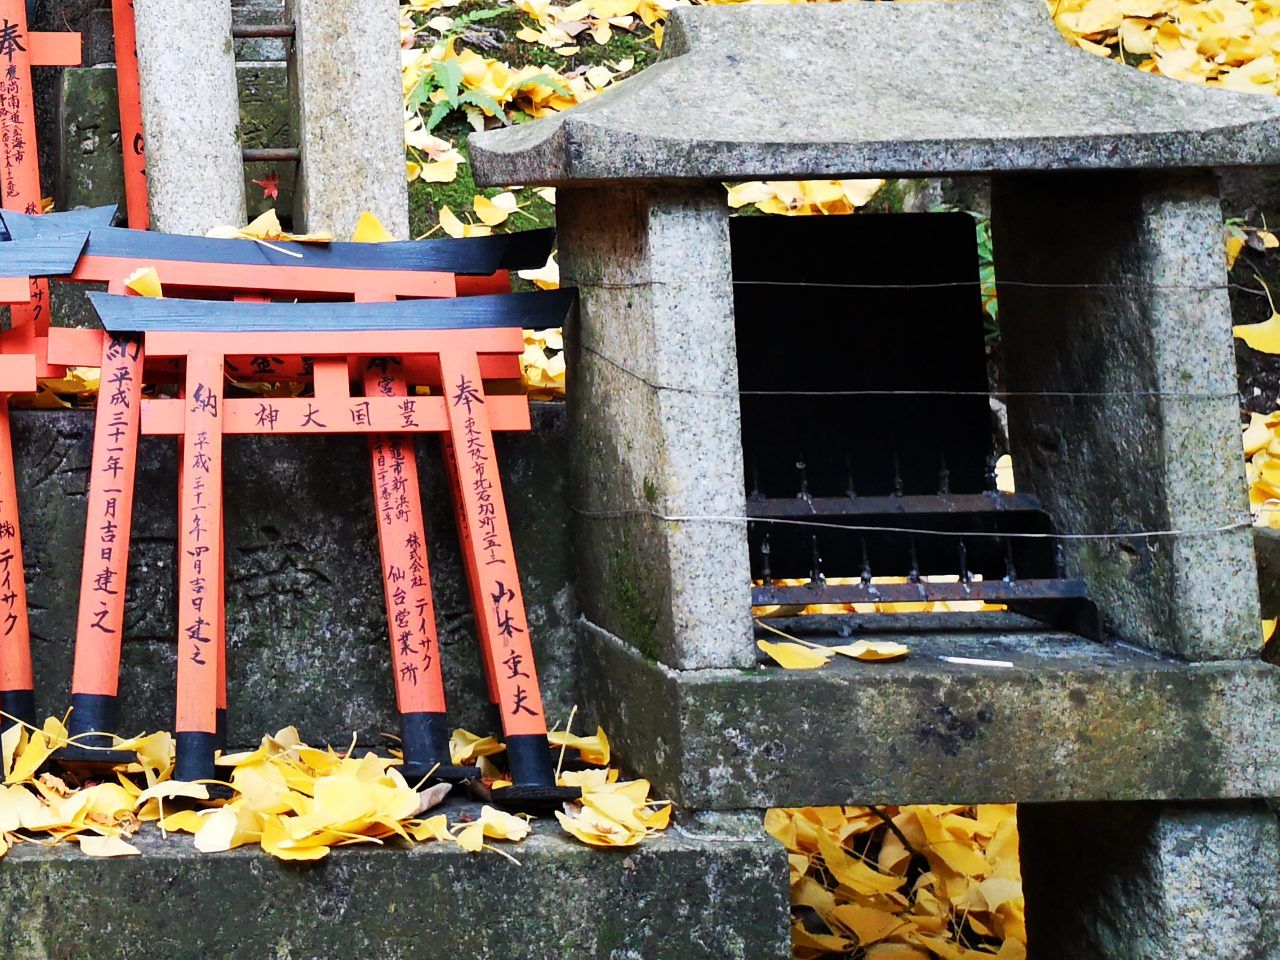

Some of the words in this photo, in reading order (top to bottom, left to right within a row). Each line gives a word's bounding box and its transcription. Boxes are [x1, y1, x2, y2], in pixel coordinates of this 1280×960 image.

[190, 383, 218, 418] 納
[405, 532, 427, 589] 株式会社
[452, 374, 485, 416] 奉
[490, 580, 539, 717] 山本重夫
[387, 565, 419, 687] 仙台営業所
